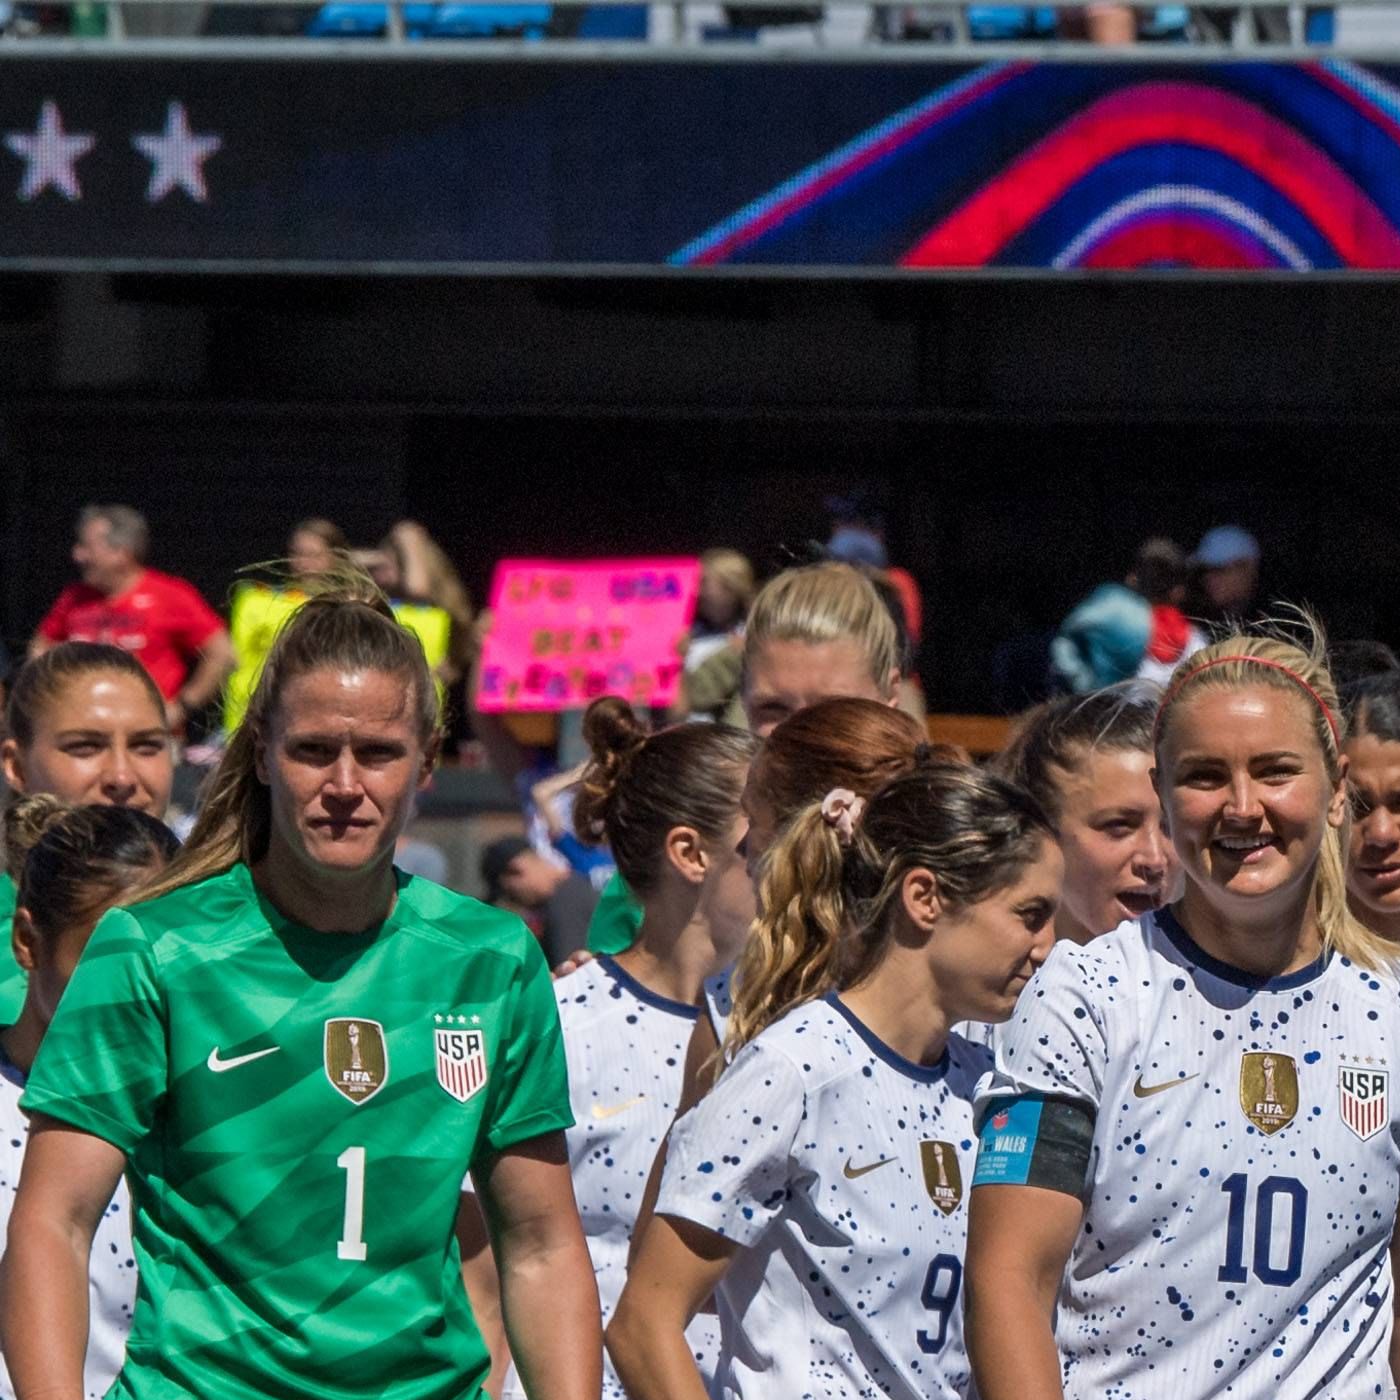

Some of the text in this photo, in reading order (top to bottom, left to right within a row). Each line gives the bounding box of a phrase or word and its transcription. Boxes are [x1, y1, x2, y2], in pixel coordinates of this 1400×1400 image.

[438, 1033, 480, 1061] USA
[343, 1070, 371, 1081] FIFA
[1342, 1070, 1385, 1100] USA
[1256, 1103, 1283, 1115] FIFA
[994, 1135, 1027, 1153] WALES
[337, 1146, 367, 1260] 1
[1217, 1172, 1308, 1287] 10
[916, 1253, 962, 1354] 9
